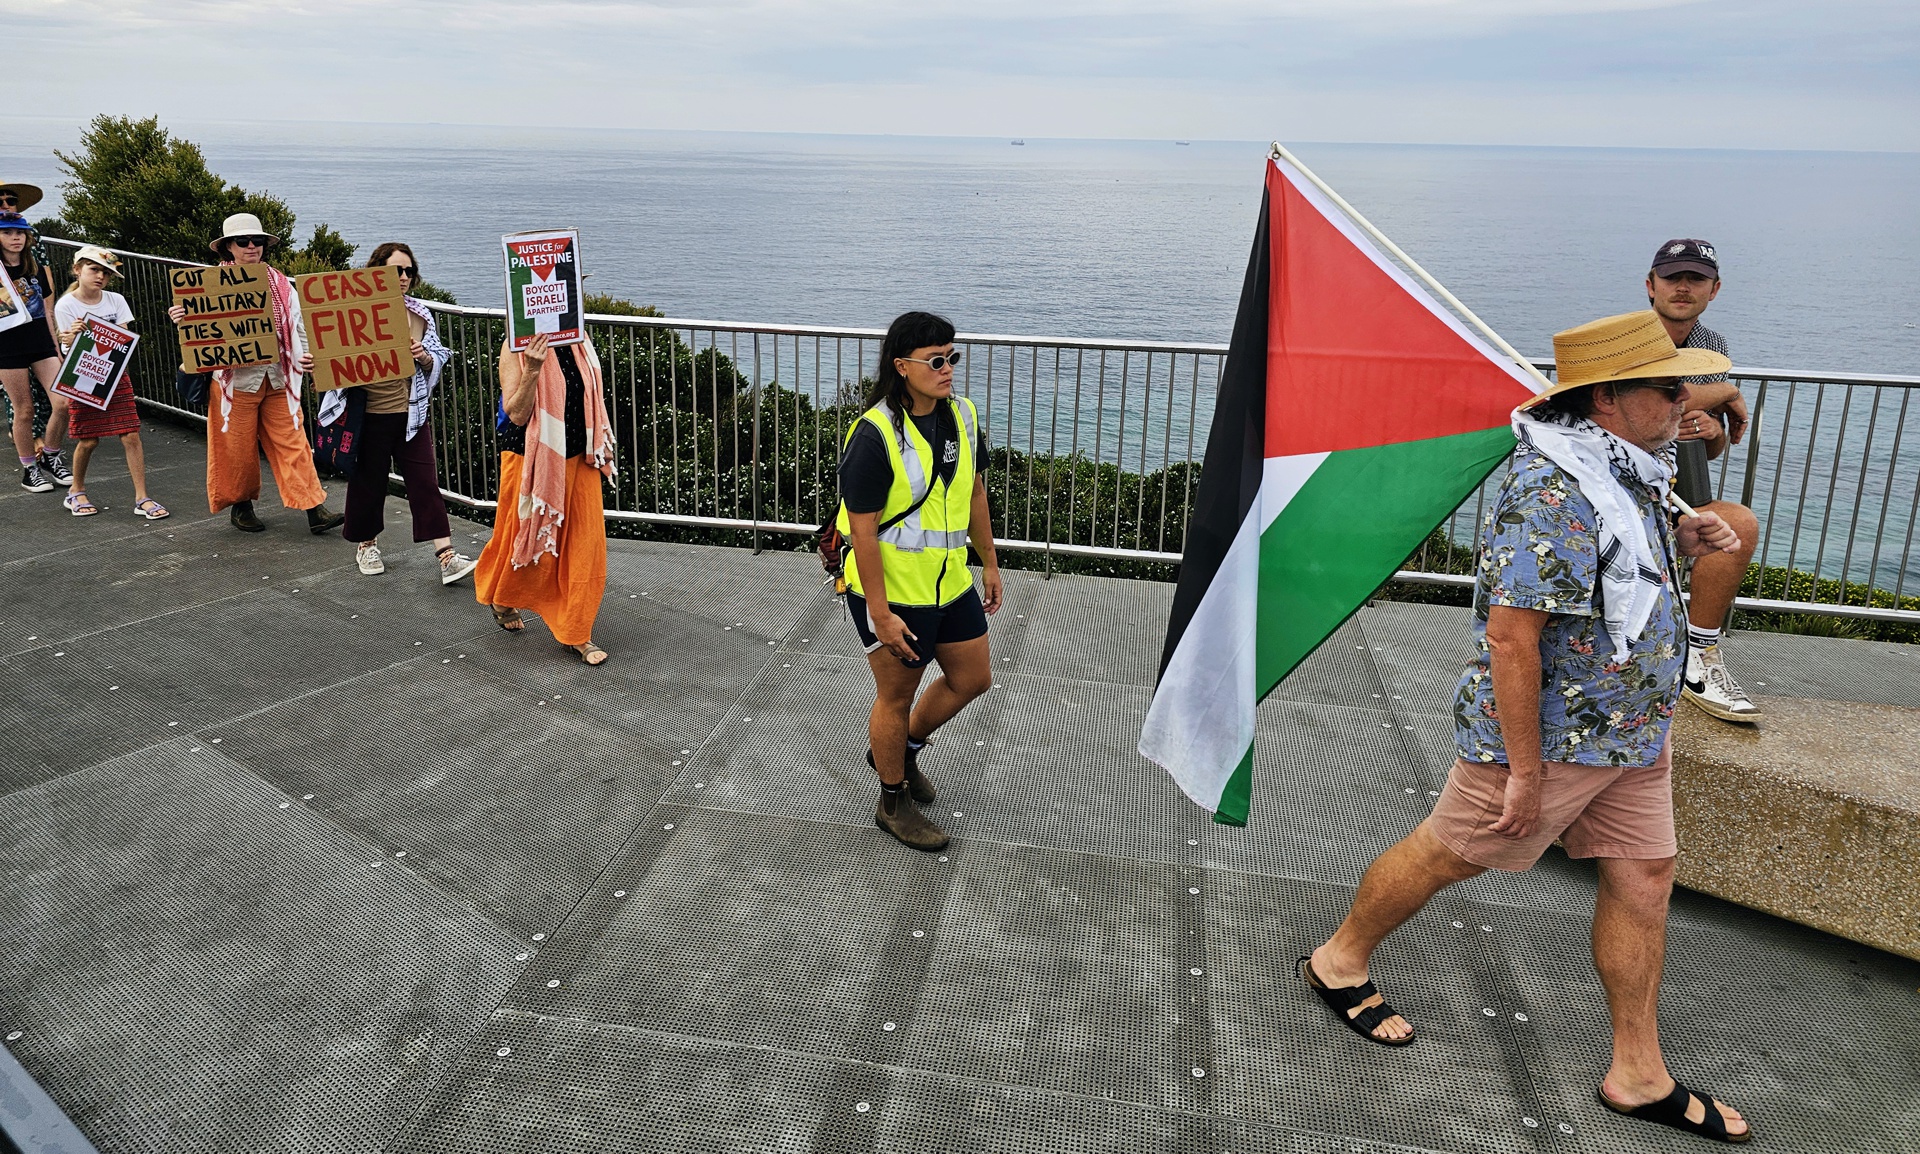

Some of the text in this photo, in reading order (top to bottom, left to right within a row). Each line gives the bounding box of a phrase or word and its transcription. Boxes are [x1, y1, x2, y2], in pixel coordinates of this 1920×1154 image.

[518, 242, 564, 254] JUSTICE for
[511, 252, 573, 268] PALESTINE
[173, 267, 257, 287] CUT ALL
[303, 270, 388, 304] CEASE
[525, 283, 565, 295] BOYCOTT
[182, 291, 267, 315] MILITARY
[526, 293, 565, 307] ISRAELI
[526, 304, 566, 316] APARTHEID
[92, 324, 118, 339] JUSTICE
[180, 317, 273, 340] TIES WITH
[311, 302, 394, 349] FIRE
[83, 330, 129, 353] PALESTINE
[82, 352, 112, 368] BOYCOTT
[193, 340, 273, 367] ISRAEL
[75, 368, 105, 383] APARTHEID
[79, 360, 109, 376] ISRAELI
[330, 349, 400, 387] NOW
